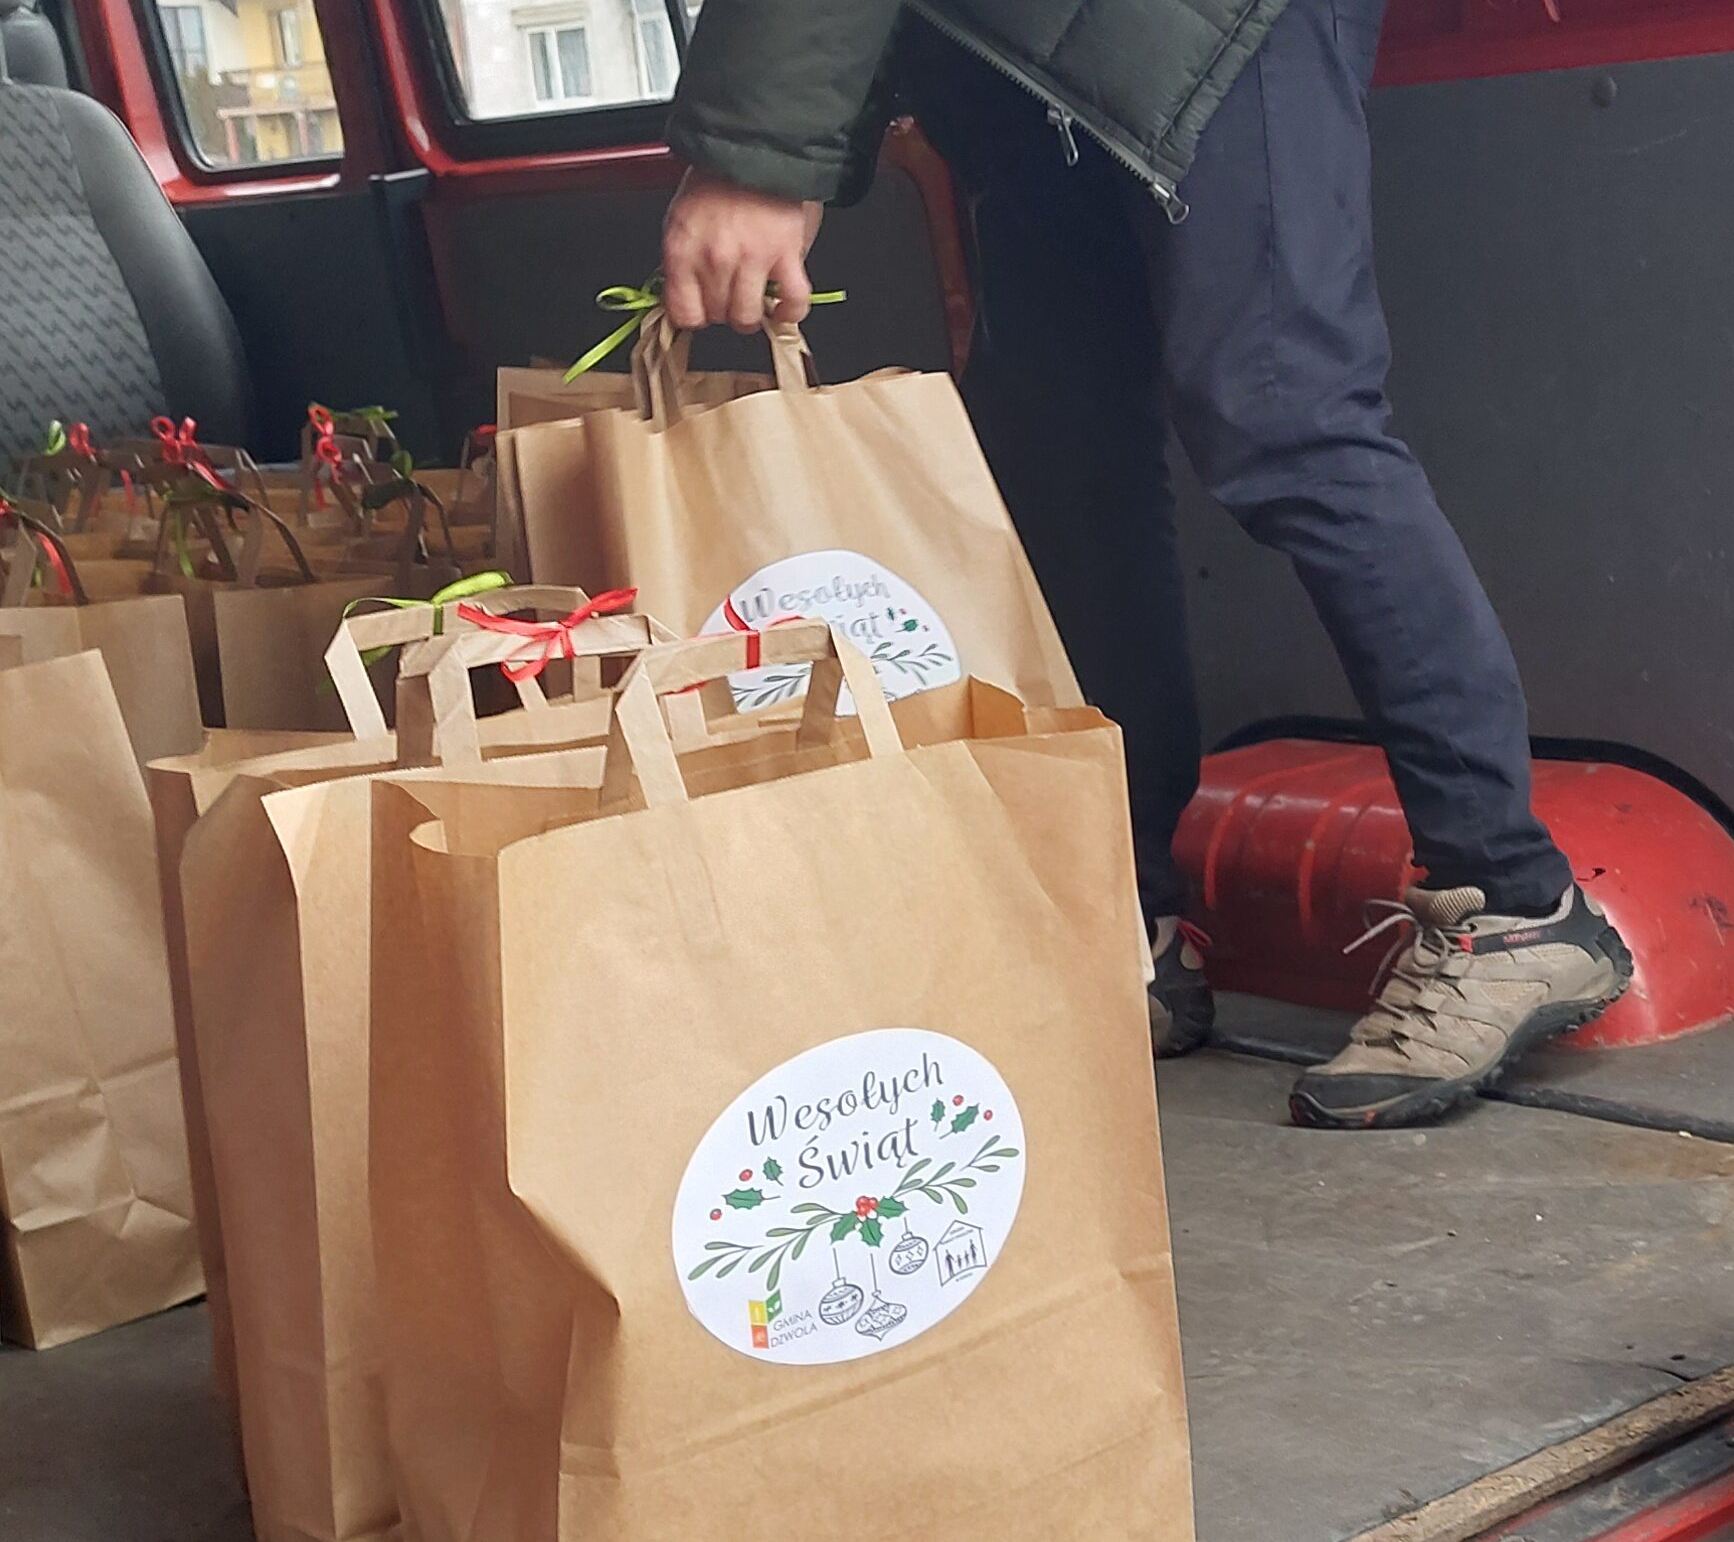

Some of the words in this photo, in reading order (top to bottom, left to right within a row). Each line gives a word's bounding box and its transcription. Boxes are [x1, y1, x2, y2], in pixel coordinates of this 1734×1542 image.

[747, 1052, 944, 1146] Wesołych
[798, 1118, 919, 1189] Świąt
[773, 1310, 813, 1331] GMINA
